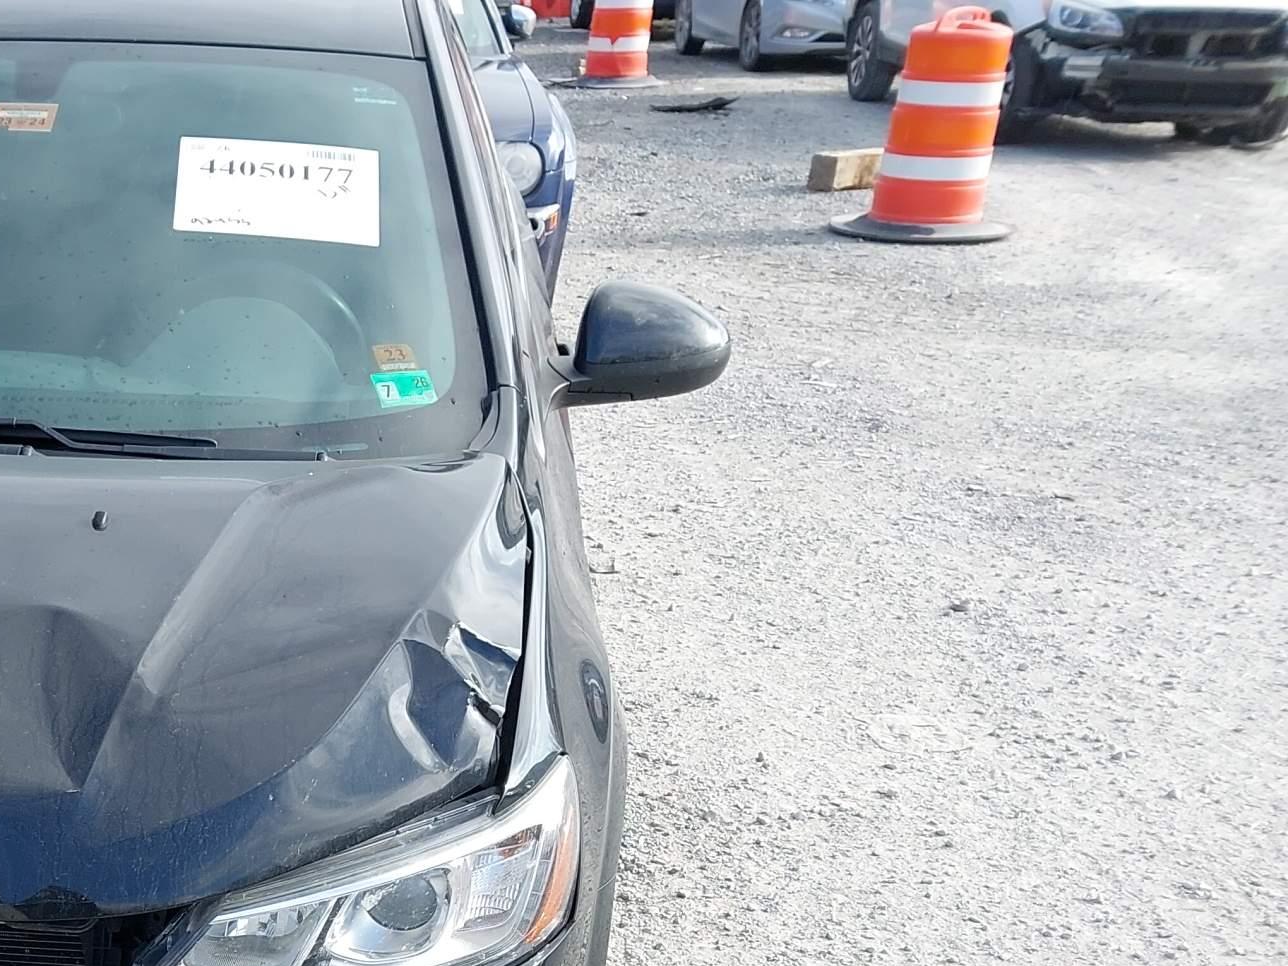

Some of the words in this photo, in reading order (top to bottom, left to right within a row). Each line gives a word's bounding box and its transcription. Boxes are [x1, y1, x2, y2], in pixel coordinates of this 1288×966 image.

[199, 159, 353, 185] 44050177
[384, 349, 406, 361] 23
[381, 384, 391, 398] 7
[413, 376, 429, 389] 26
